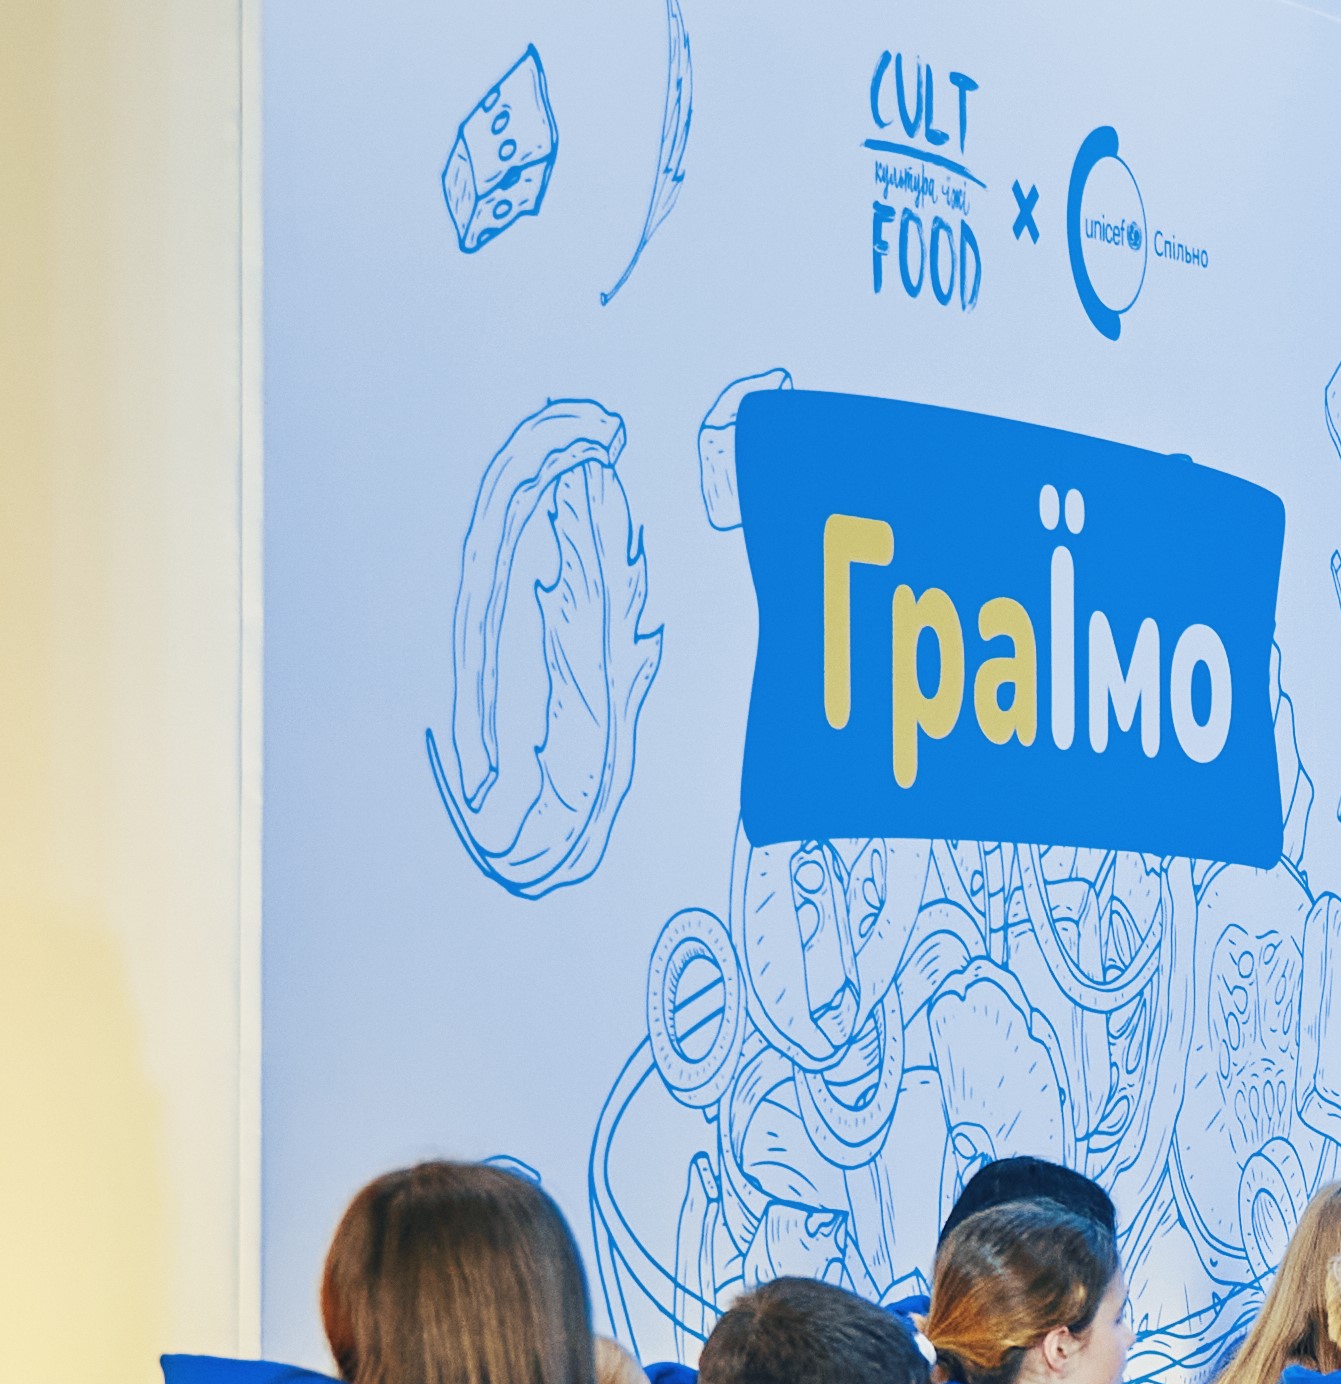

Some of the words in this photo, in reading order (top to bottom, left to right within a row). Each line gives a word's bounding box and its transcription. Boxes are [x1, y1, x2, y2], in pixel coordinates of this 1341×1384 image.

[870, 50, 979, 154] CULT
[872, 200, 982, 313] FOOD
[1085, 213, 1126, 246] unicef
[1153, 230, 1209, 269] Спільно
[823, 483, 1233, 789] ГраЇмо
